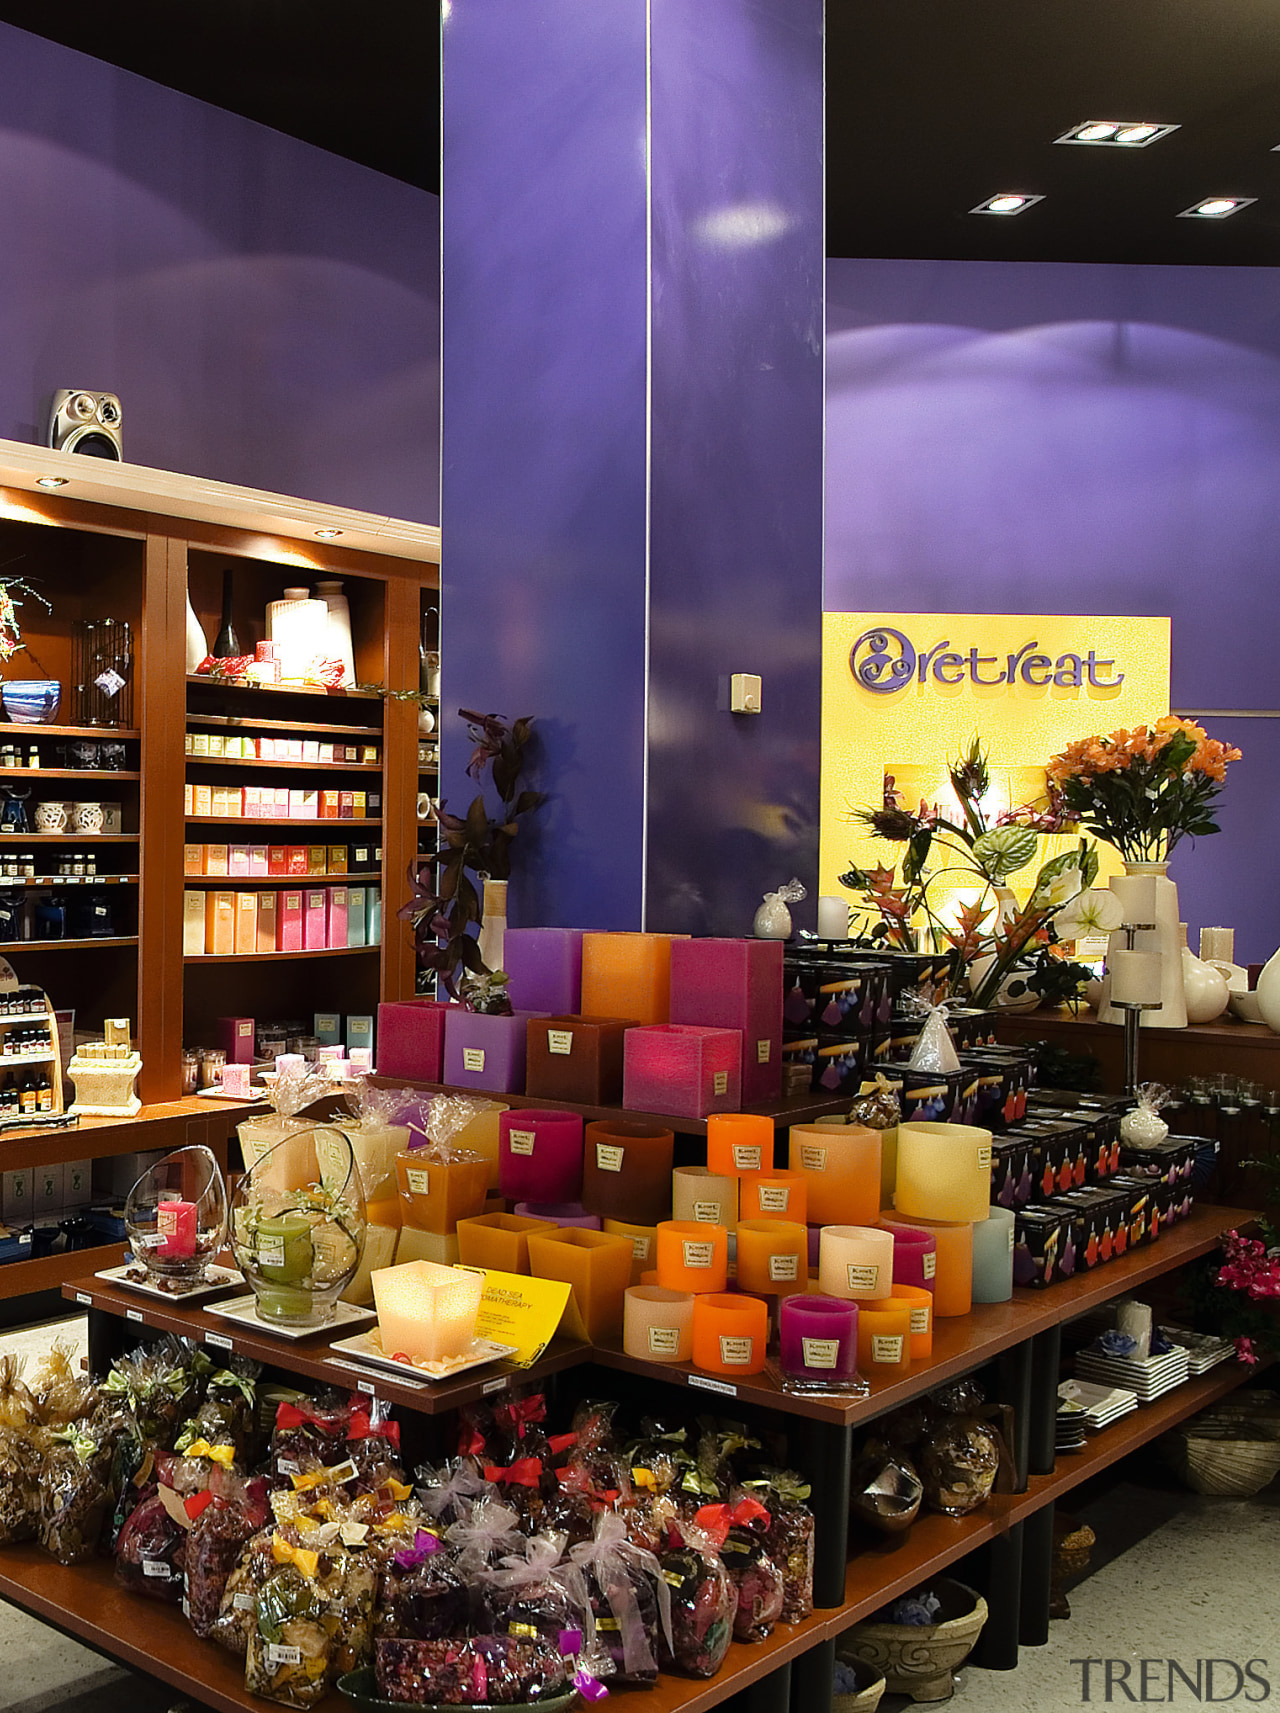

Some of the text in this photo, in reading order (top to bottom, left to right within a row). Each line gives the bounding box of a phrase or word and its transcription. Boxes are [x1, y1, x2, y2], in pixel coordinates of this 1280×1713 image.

[917, 640, 1125, 687] retreat
[486, 1286, 523, 1299] DEAD SEA
[481, 1294, 533, 1309] OMATHERAPY
